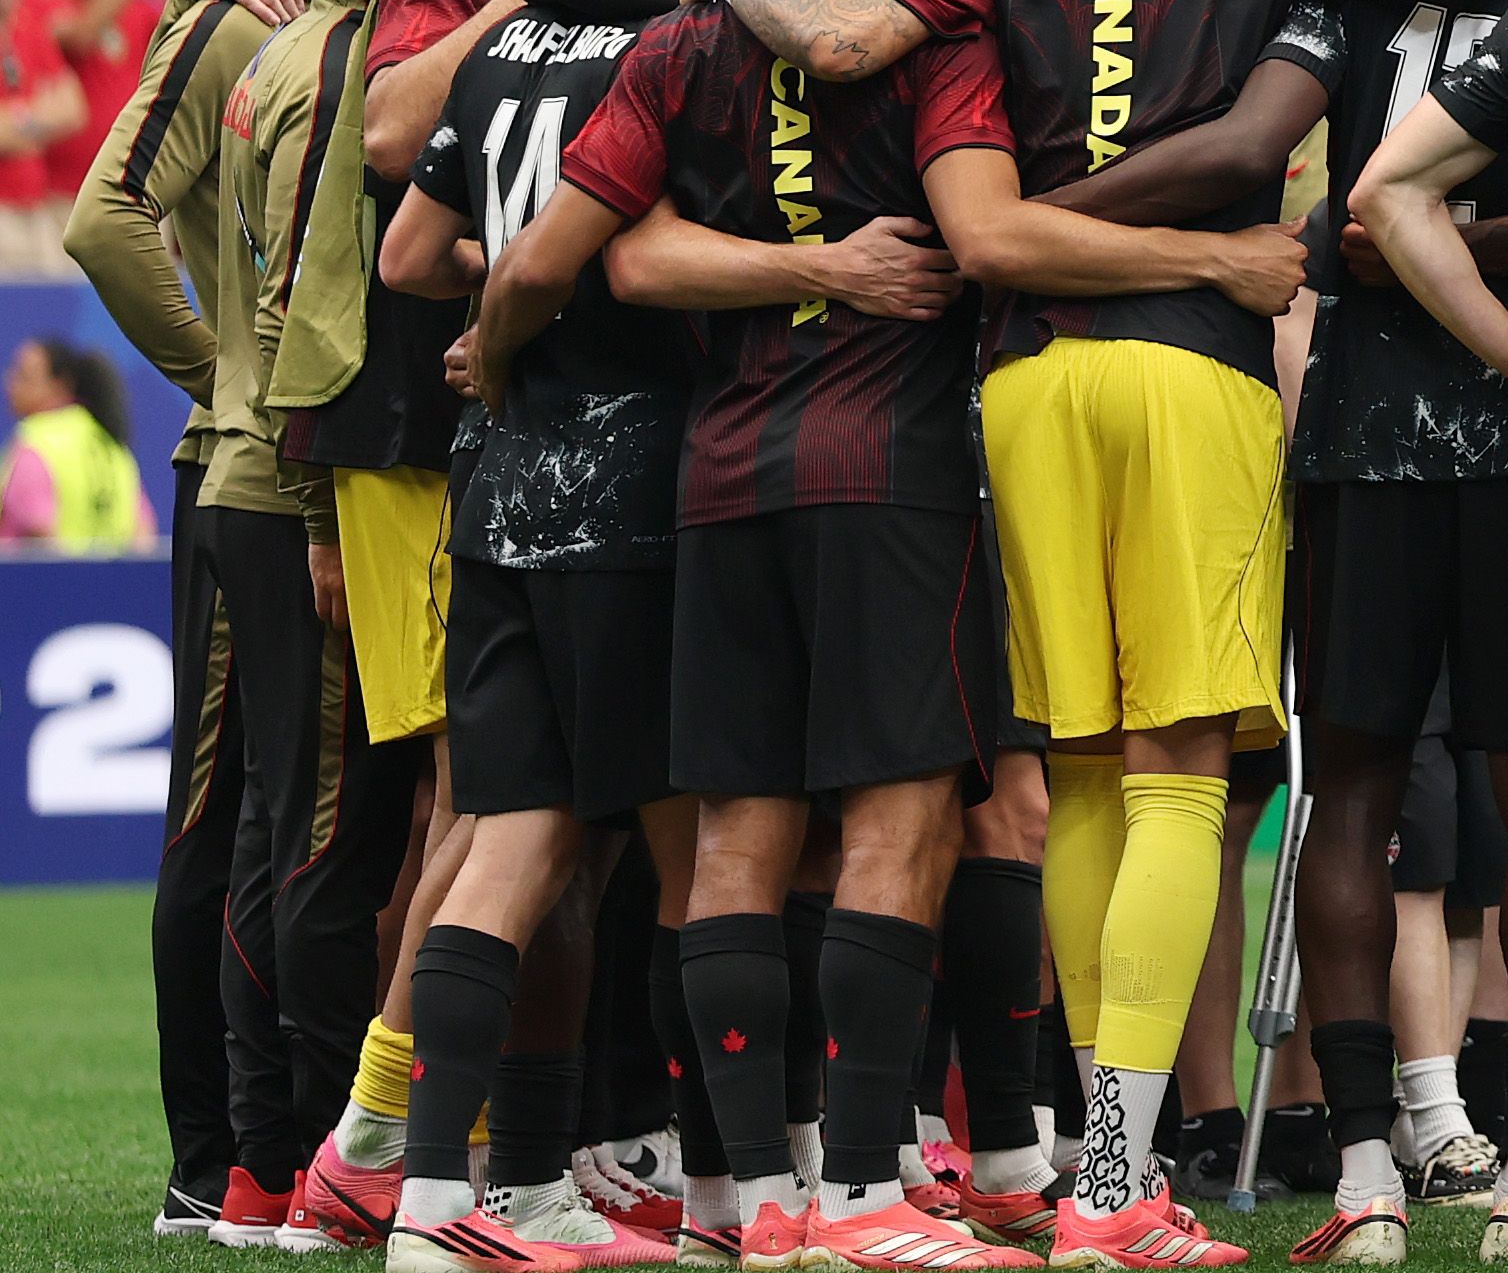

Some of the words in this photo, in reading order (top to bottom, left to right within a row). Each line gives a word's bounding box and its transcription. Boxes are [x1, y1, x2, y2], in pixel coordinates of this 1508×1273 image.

[481, 95, 569, 274] 14
[770, 57, 829, 328] CANAA
[26, 622, 175, 817] 2
